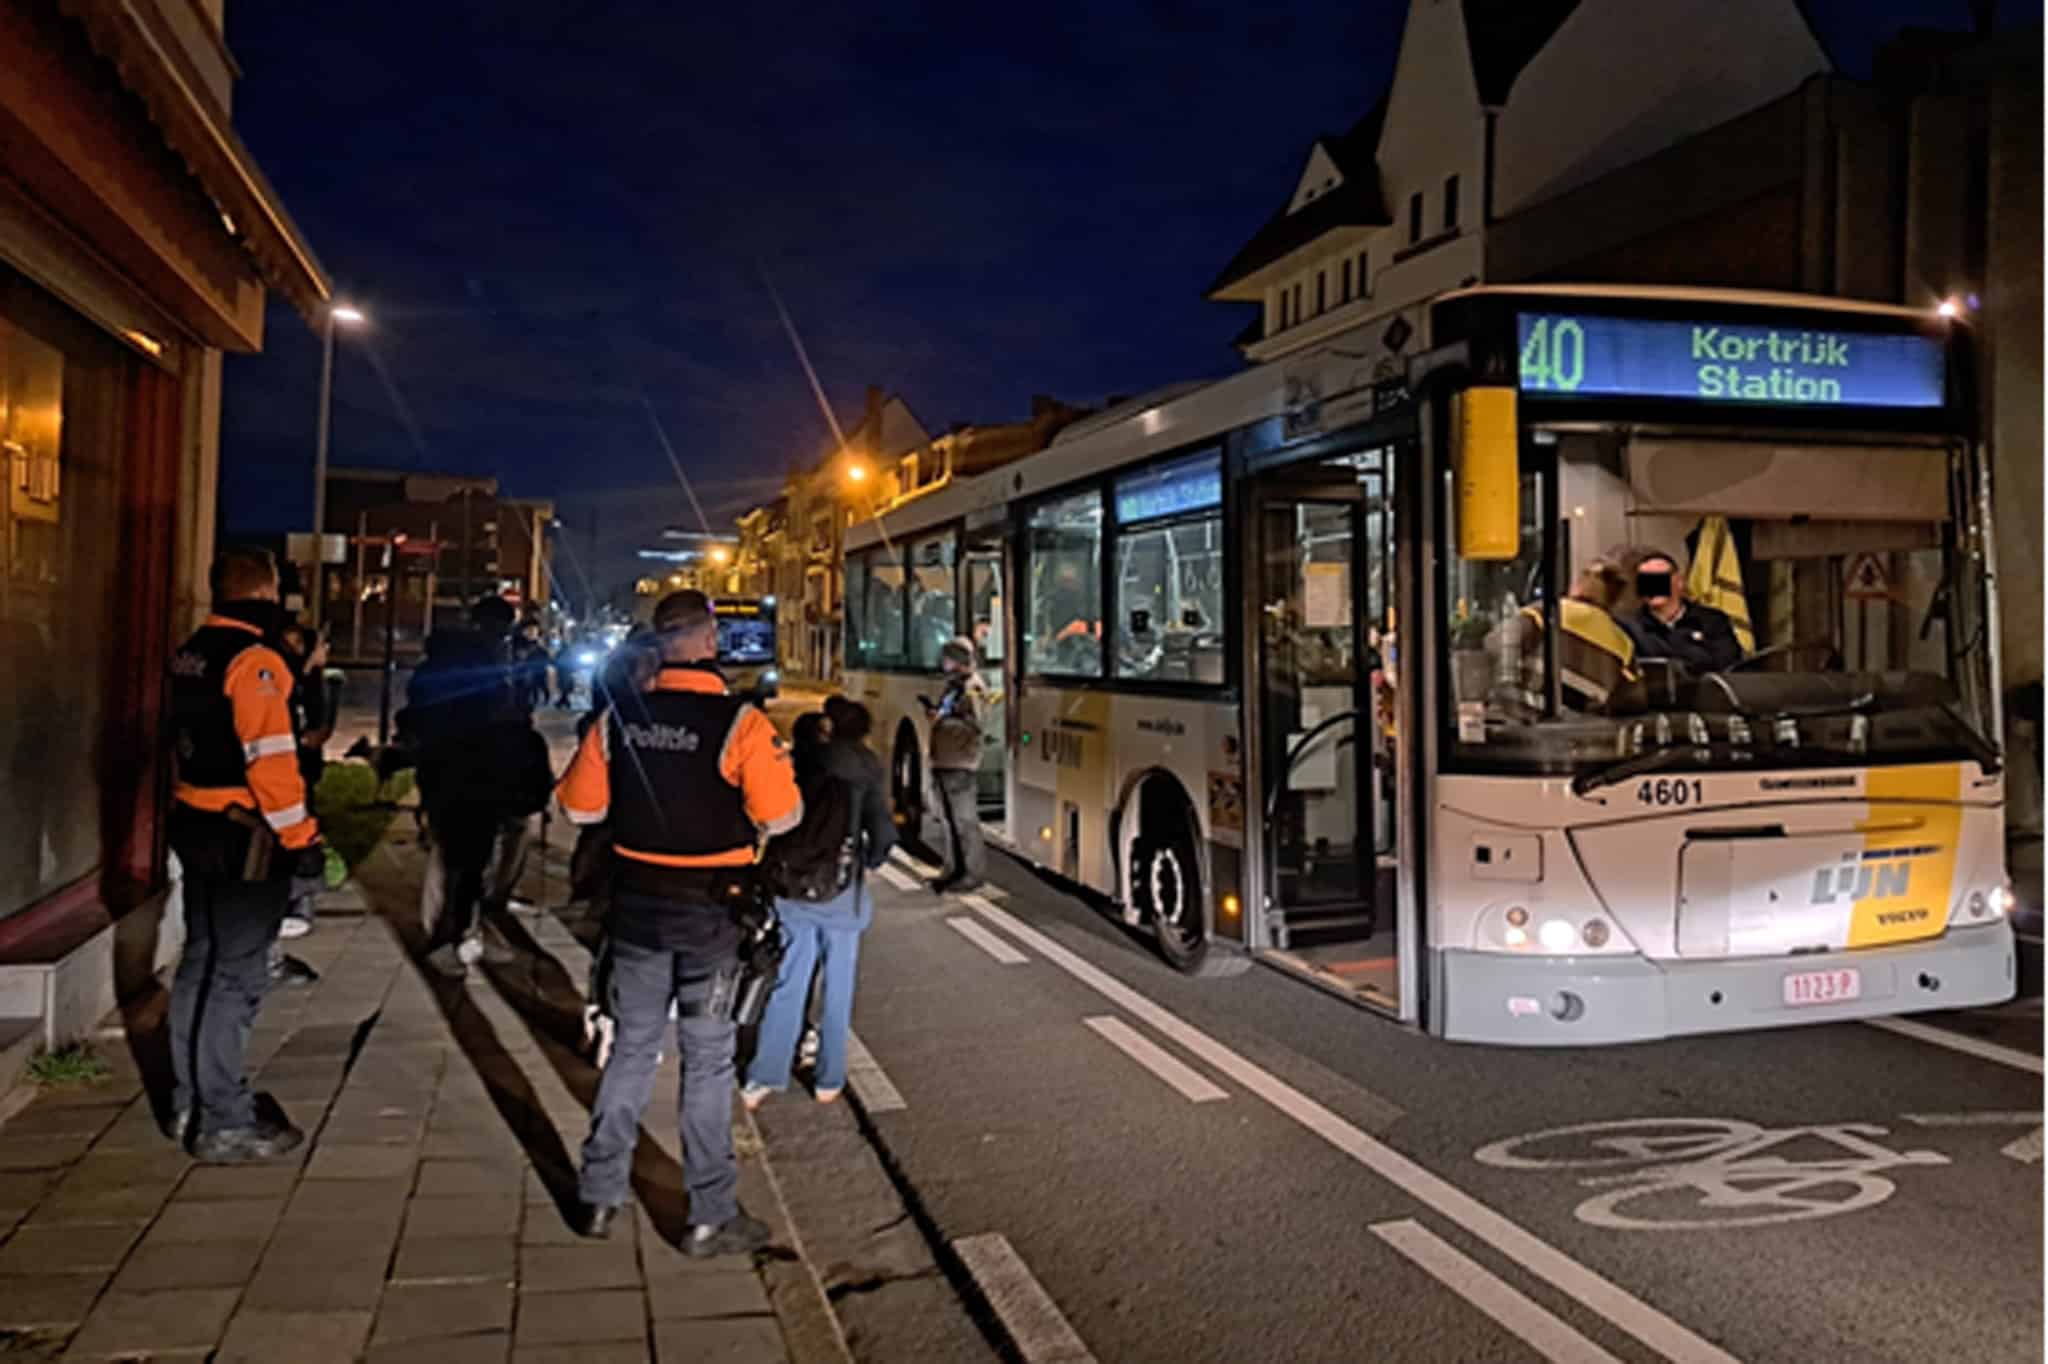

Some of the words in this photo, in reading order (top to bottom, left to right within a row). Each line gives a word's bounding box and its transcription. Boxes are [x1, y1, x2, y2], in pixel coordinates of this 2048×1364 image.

[1520, 318, 1584, 391] 40
[1692, 327, 1849, 367] Kortrijk
[1699, 364, 1841, 402] Station
[623, 723, 701, 752] Politie
[1637, 778, 1703, 805] 4601
